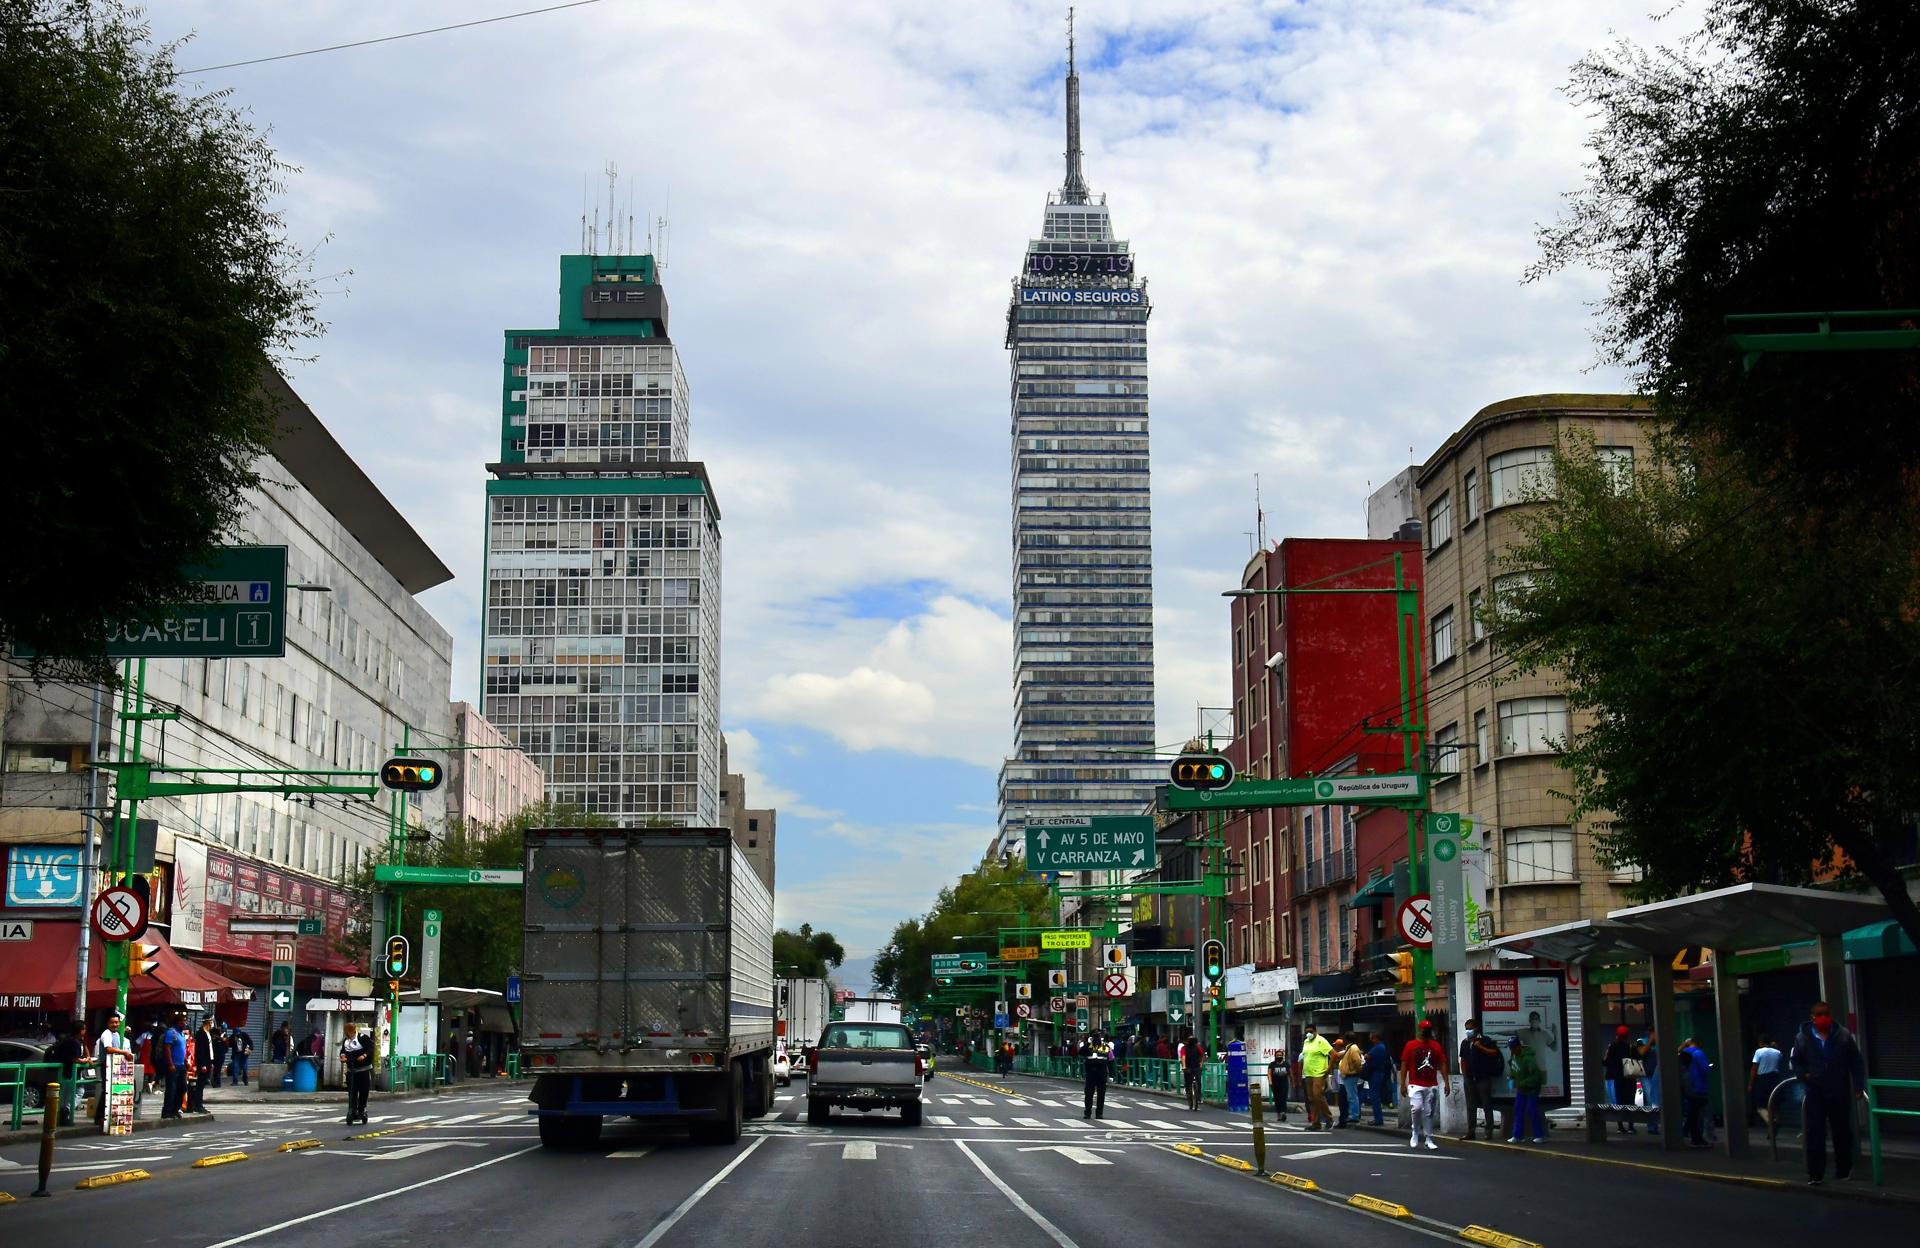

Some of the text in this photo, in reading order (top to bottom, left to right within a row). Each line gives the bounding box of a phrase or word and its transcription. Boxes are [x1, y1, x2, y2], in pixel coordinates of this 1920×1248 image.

[1023, 291, 1139, 303] LATINO SEGUROS
[250, 621, 257, 639] 1
[1338, 784, 1370, 792] República
[1381, 782, 1409, 790] Uruguay
[1061, 832, 1144, 846] AV 5 DE MAYO
[1037, 851, 1121, 864] V CARRANZA
[23, 854, 73, 881] WC
[13, 996, 41, 1008] POCHO
[336, 999, 352, 1012] 188
